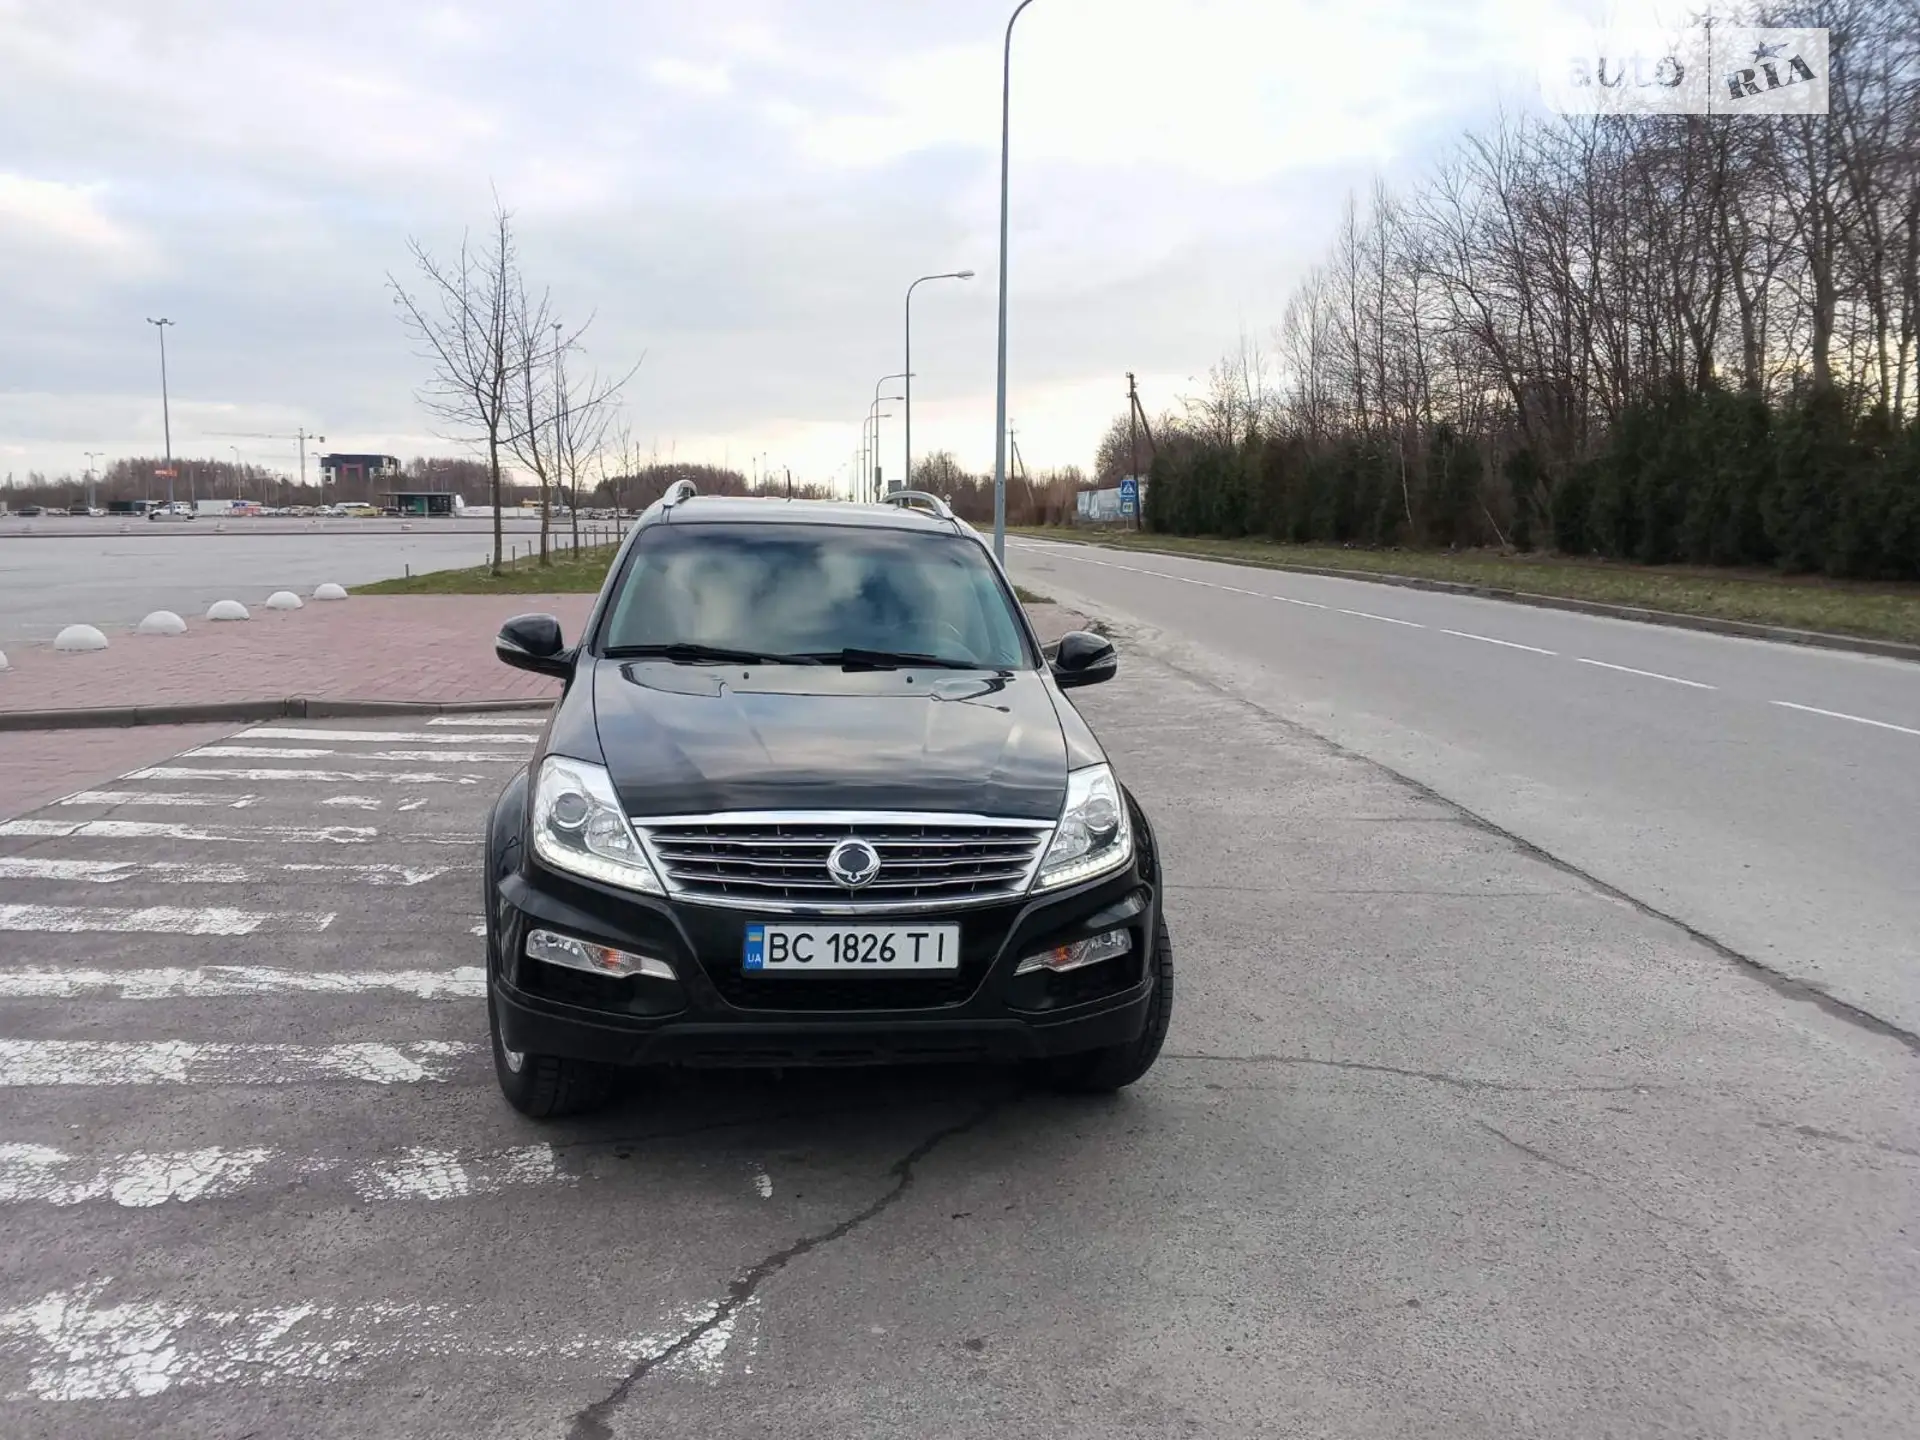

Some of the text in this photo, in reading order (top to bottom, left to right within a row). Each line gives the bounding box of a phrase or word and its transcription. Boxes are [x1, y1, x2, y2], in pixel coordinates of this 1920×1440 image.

[768, 932, 814, 963] BC
[826, 932, 896, 963] 1826
[747, 953, 761, 963] UA
